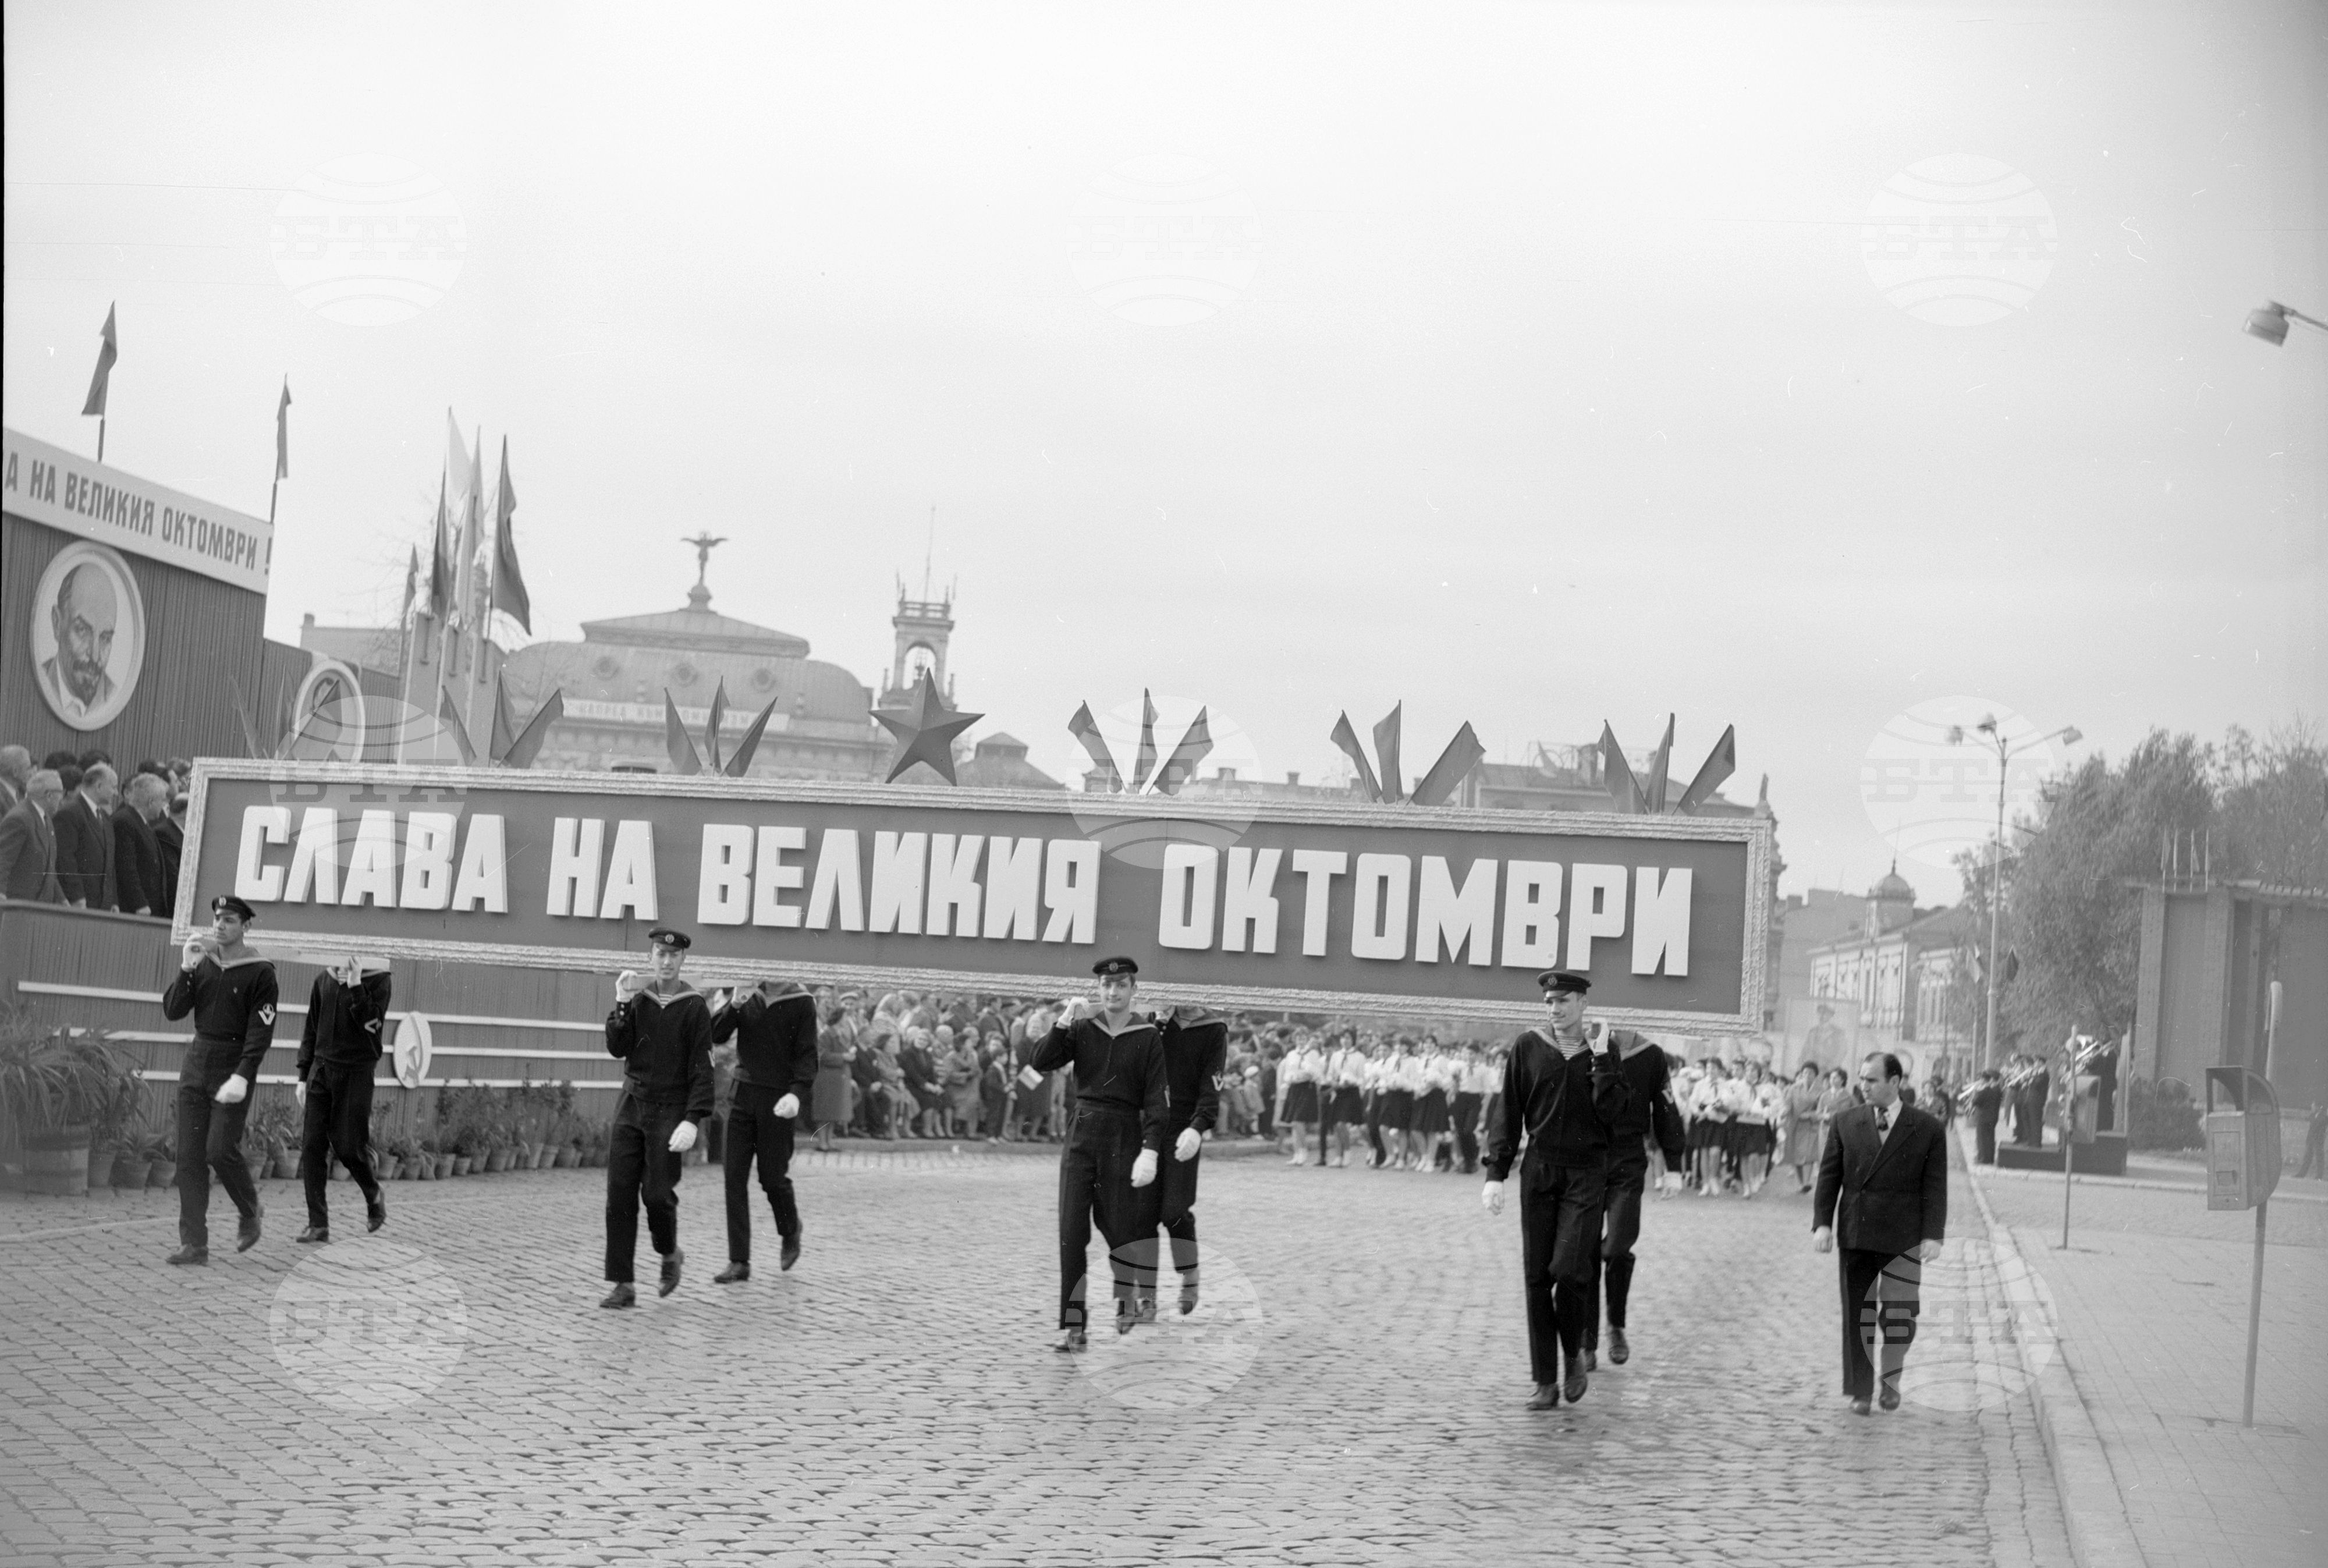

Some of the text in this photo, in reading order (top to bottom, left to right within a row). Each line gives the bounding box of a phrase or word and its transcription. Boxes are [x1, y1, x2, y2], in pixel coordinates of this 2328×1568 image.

[5, 451, 18, 491] А
[30, 459, 56, 504] НА
[65, 471, 155, 537] ВЕЛИКИЯ
[162, 506, 257, 570] ОКТОМВРИ
[235, 805, 1693, 976] СЛАВА НА ВЕЛИКИЯ ОКТОМВРИ
